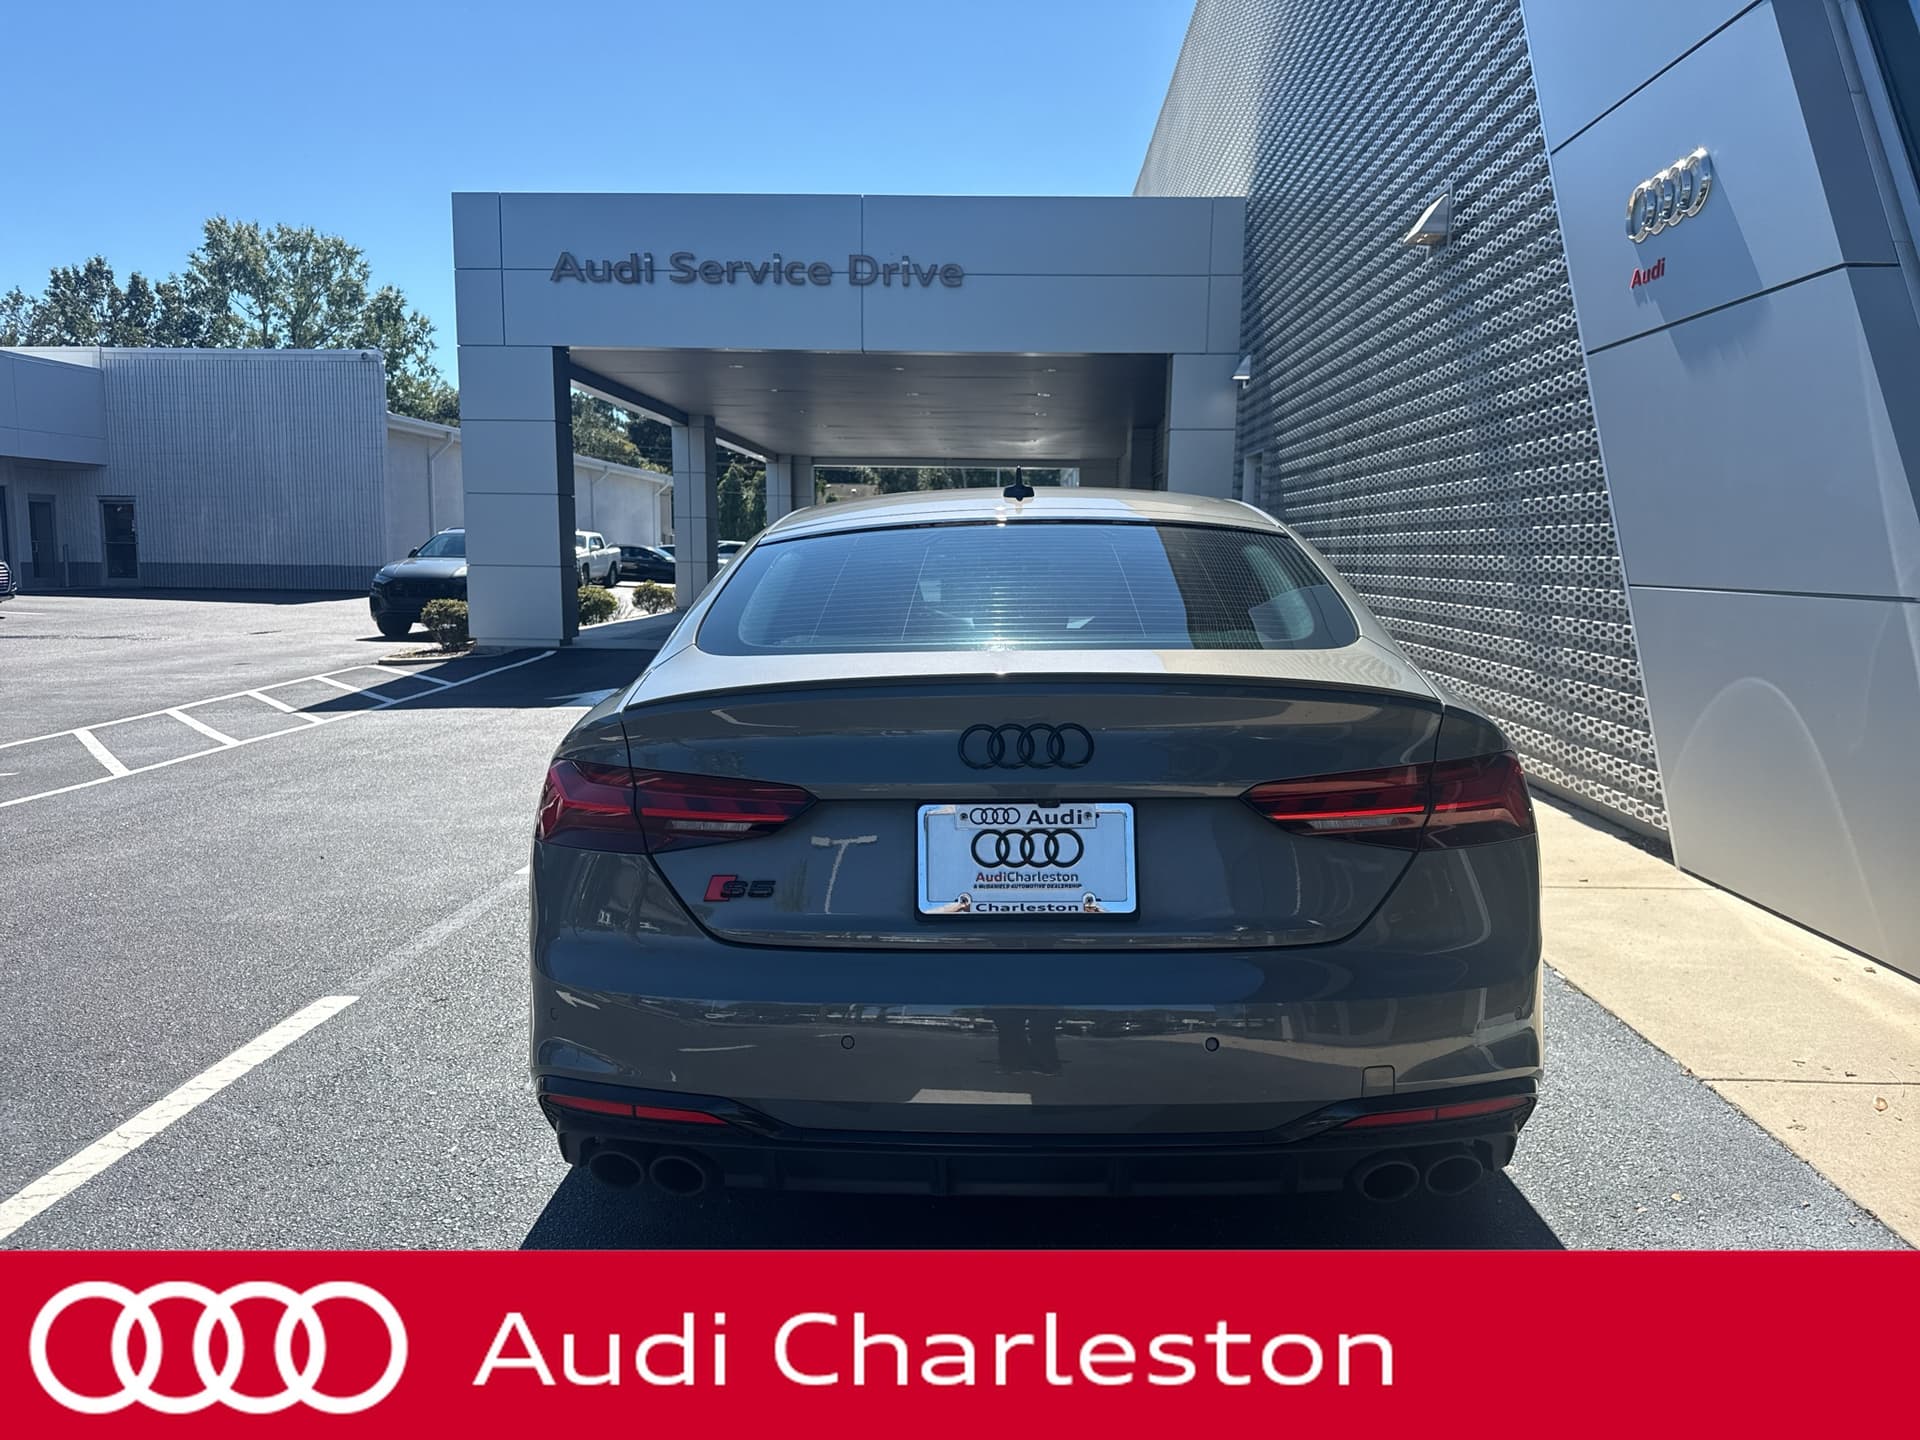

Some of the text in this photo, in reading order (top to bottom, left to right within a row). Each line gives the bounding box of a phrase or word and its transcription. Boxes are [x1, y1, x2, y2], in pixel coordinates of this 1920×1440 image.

[551, 251, 963, 288] Audi Service Drive
[1629, 257, 1666, 290] Audi
[1026, 809, 1083, 825] Audi
[975, 871, 1079, 882] AudiCharleston
[720, 879, 777, 899] S5
[975, 903, 1079, 912] Charleston
